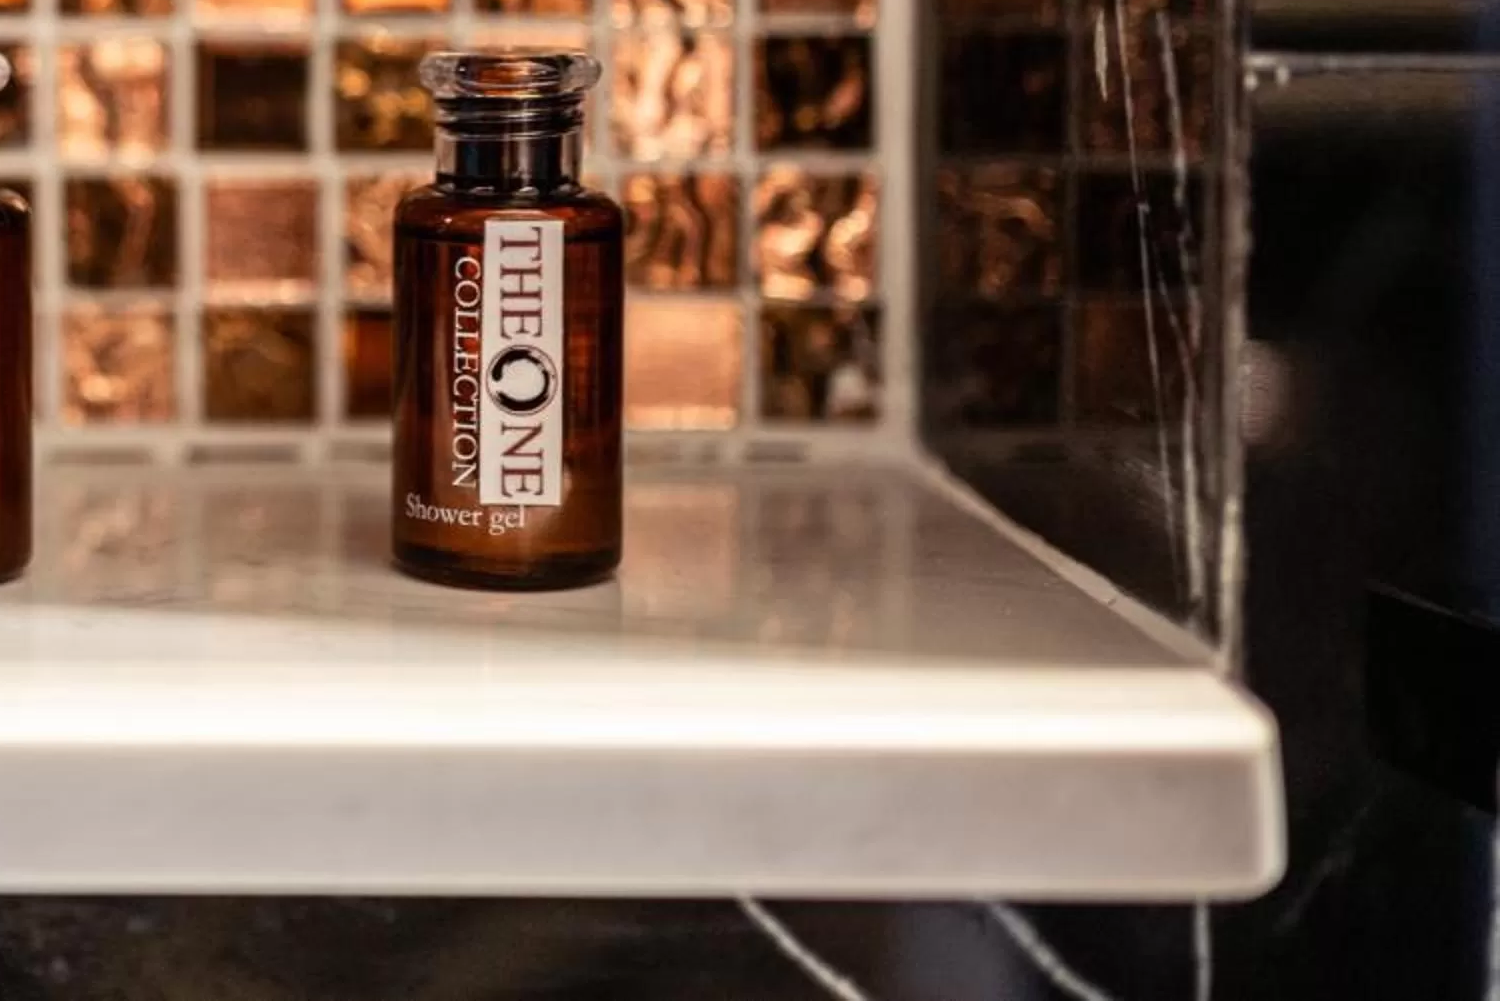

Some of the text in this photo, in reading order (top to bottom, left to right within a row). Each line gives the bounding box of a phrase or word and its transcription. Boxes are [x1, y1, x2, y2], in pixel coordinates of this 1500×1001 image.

[452, 256, 481, 489] COLLECTION
[486, 226, 558, 498] THE ONE
[405, 493, 525, 535] Shower gel
